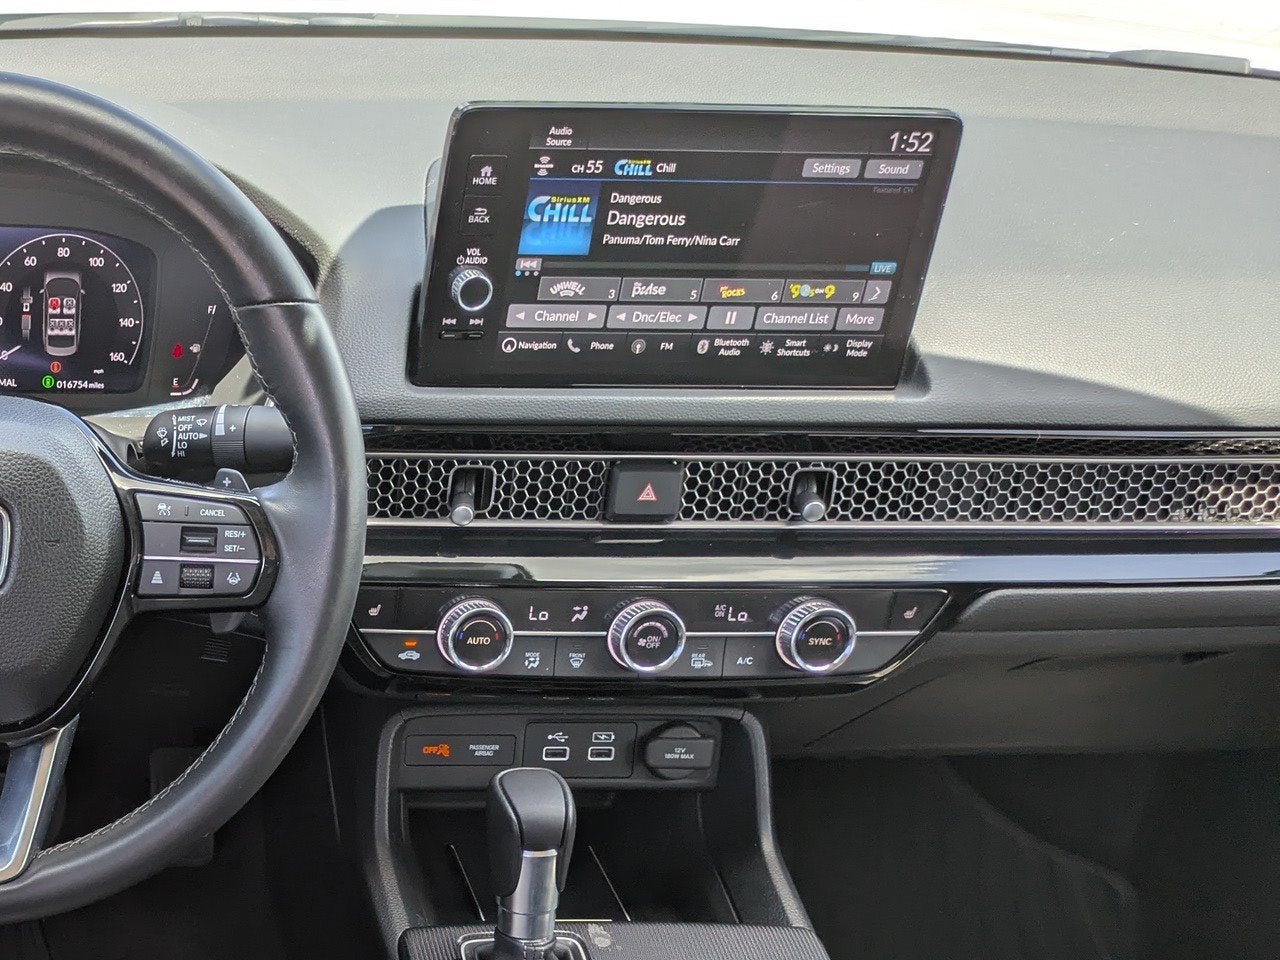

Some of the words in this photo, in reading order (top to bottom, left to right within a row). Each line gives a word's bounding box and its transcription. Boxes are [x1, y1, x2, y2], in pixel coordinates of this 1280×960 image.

[549, 127, 572, 136] Audio
[546, 137, 571, 146] Source
[889, 132, 933, 152] 1:52
[572, 164, 585, 173] CH
[587, 160, 603, 173] 55
[615, 159, 653, 176] CHILL
[656, 163, 676, 173] Chill
[813, 163, 850, 174] Settings
[878, 164, 909, 174] Sound
[473, 177, 497, 185] HOME
[611, 193, 662, 204] Dangerous
[528, 196, 592, 222] CHILL
[468, 215, 490, 224] BACK
[607, 210, 686, 227] Dangerous
[603, 234, 665, 246] Panuma/Tom
[667, 235, 717, 247] Ferry/Nina
[719, 236, 740, 246] Carr
[57, 247, 70, 257] 80
[24, 257, 37, 267] 60
[89, 257, 104, 267] 100
[465, 256, 487, 265] AUDIO
[874, 265, 891, 273] LIVE
[0, 282, 12, 292] 40
[112, 283, 128, 293] 120
[549, 280, 586, 295] UNWELL
[608, 290, 615, 299] 3
[690, 290, 697, 299] 5
[771, 291, 778, 301] 6
[852, 292, 859, 301] 9
[534, 310, 579, 322] Channel
[633, 311, 682, 323] Dnc/Elec
[763, 312, 807, 324] Channel
[809, 313, 829, 324] List
[845, 314, 874, 324] More
[119, 317, 135, 328] 140
[518, 340, 557, 351] Navigation
[590, 341, 614, 350] Phone
[660, 342, 673, 350] FM
[714, 338, 749, 347] Bluetooth
[785, 338, 806, 347] Smart
[846, 339, 873, 349] Display
[109, 352, 125, 362] 160
[718, 348, 740, 356] Audio
[777, 348, 810, 357] Shortcuts
[846, 349, 868, 357] Mode
[57, 380, 88, 389] 016754
[89, 381, 105, 389] miles
[200, 509, 225, 517] CANCEL
[467, 637, 490, 645] AUTO
[808, 638, 832, 646] SYNC
[737, 657, 753, 665] A/C
[423, 746, 438, 754] OFF
